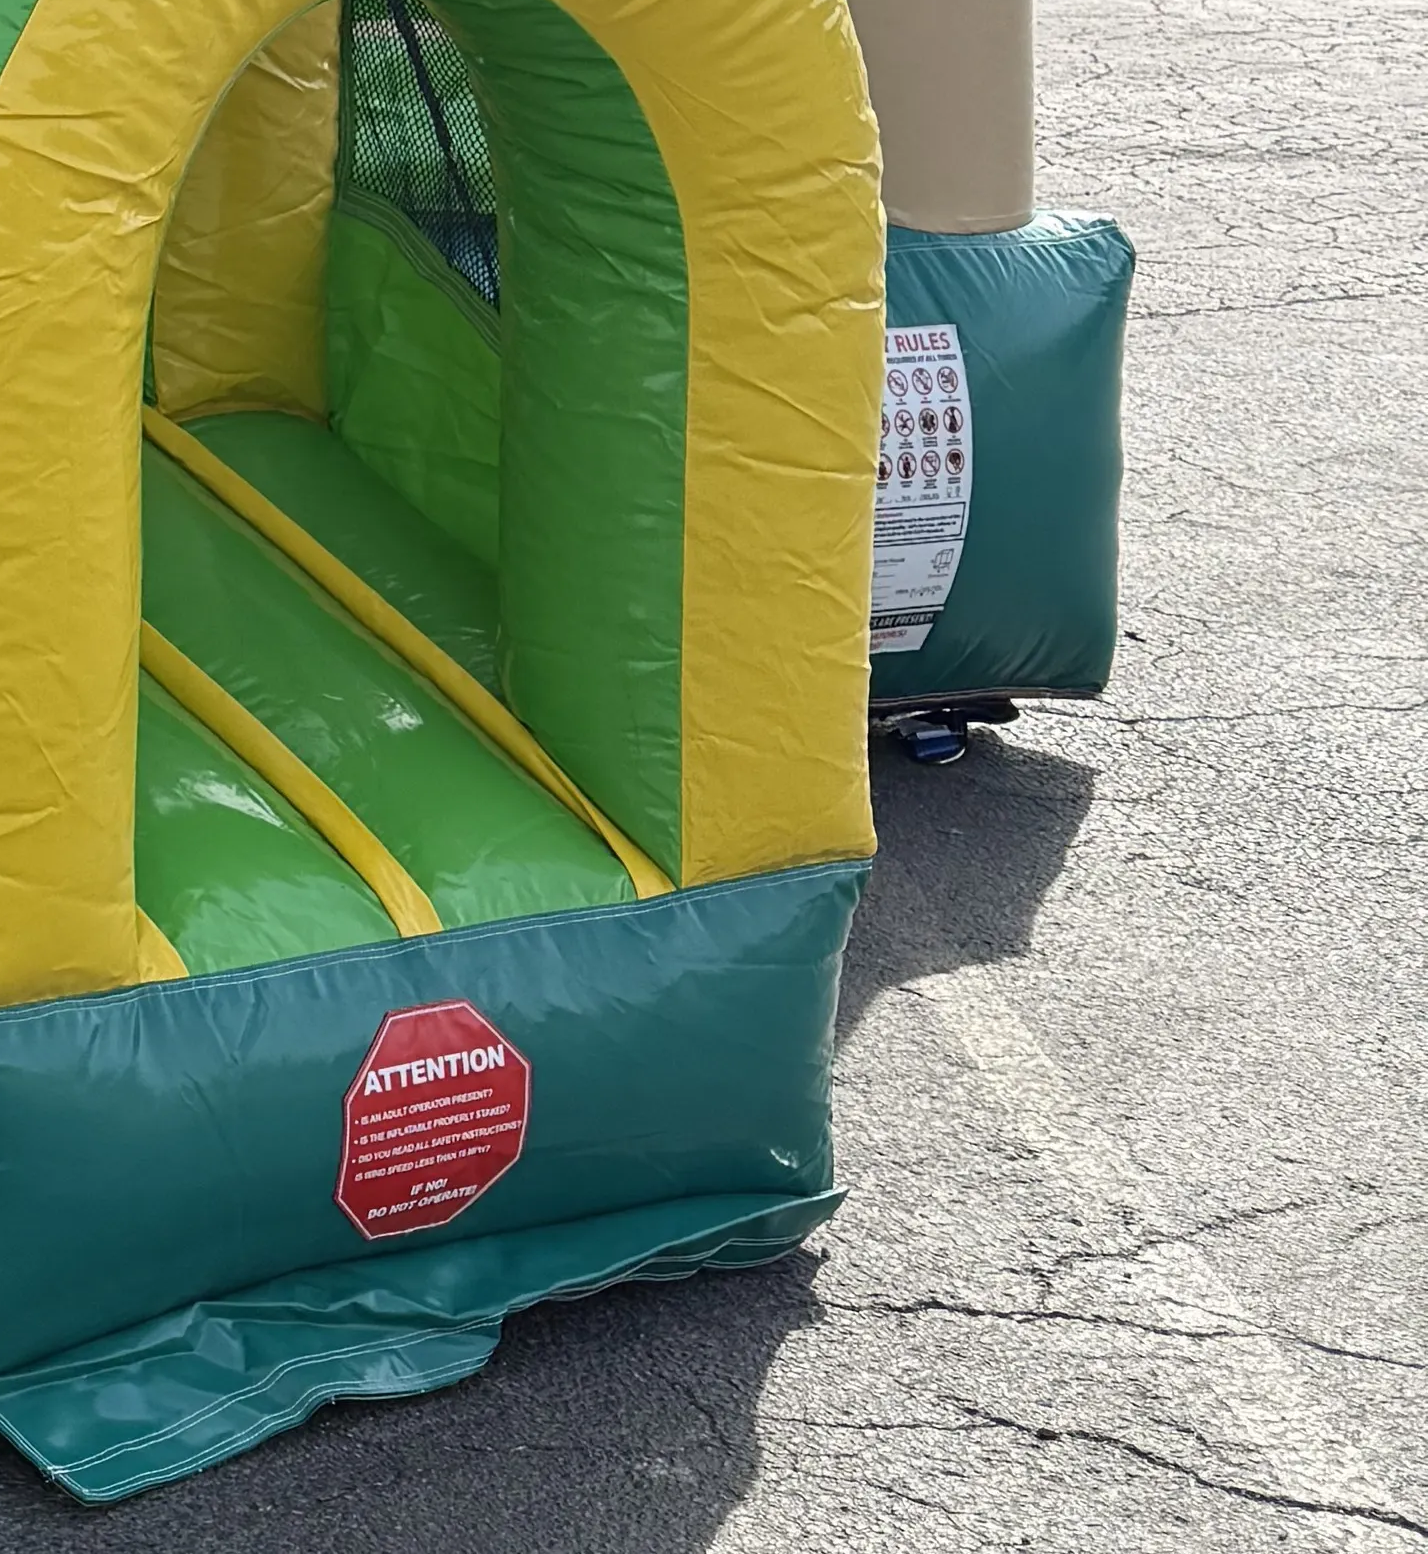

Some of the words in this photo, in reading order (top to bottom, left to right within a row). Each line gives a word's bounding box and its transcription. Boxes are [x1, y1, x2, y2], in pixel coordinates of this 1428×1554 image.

[894, 332, 951, 353] RULES
[364, 1043, 506, 1096] ATTENTION
[360, 1115, 368, 1125] IS
[370, 1112, 382, 1123] AN
[382, 1106, 408, 1121] ADULT
[409, 1096, 452, 1114] OPERATOR
[452, 1088, 493, 1105] PRESENT?
[360, 1135, 368, 1145] IS
[370, 1131, 386, 1143] THE
[386, 1120, 433, 1140] INFLATABLE
[433, 1111, 475, 1129] PROPERLY
[475, 1103, 510, 1119] STAKED?
[358, 1152, 373, 1164] DID
[374, 1148, 391, 1160] YOU
[392, 1143, 414, 1157] READ
[414, 1141, 430, 1153] ALL
[430, 1133, 461, 1148] SAFETY
[460, 1119, 522, 1141] INSTRUCTIONS?
[364, 1166, 386, 1180] WIND
[386, 1161, 414, 1175] SPEED
[414, 1156, 435, 1169] LESS
[436, 1152, 457, 1165] THAN
[367, 1206, 388, 1220] DO
[388, 1199, 418, 1215] NOT
[417, 1184, 478, 1207] OPERATE!
[410, 1183, 424, 1196] IF
